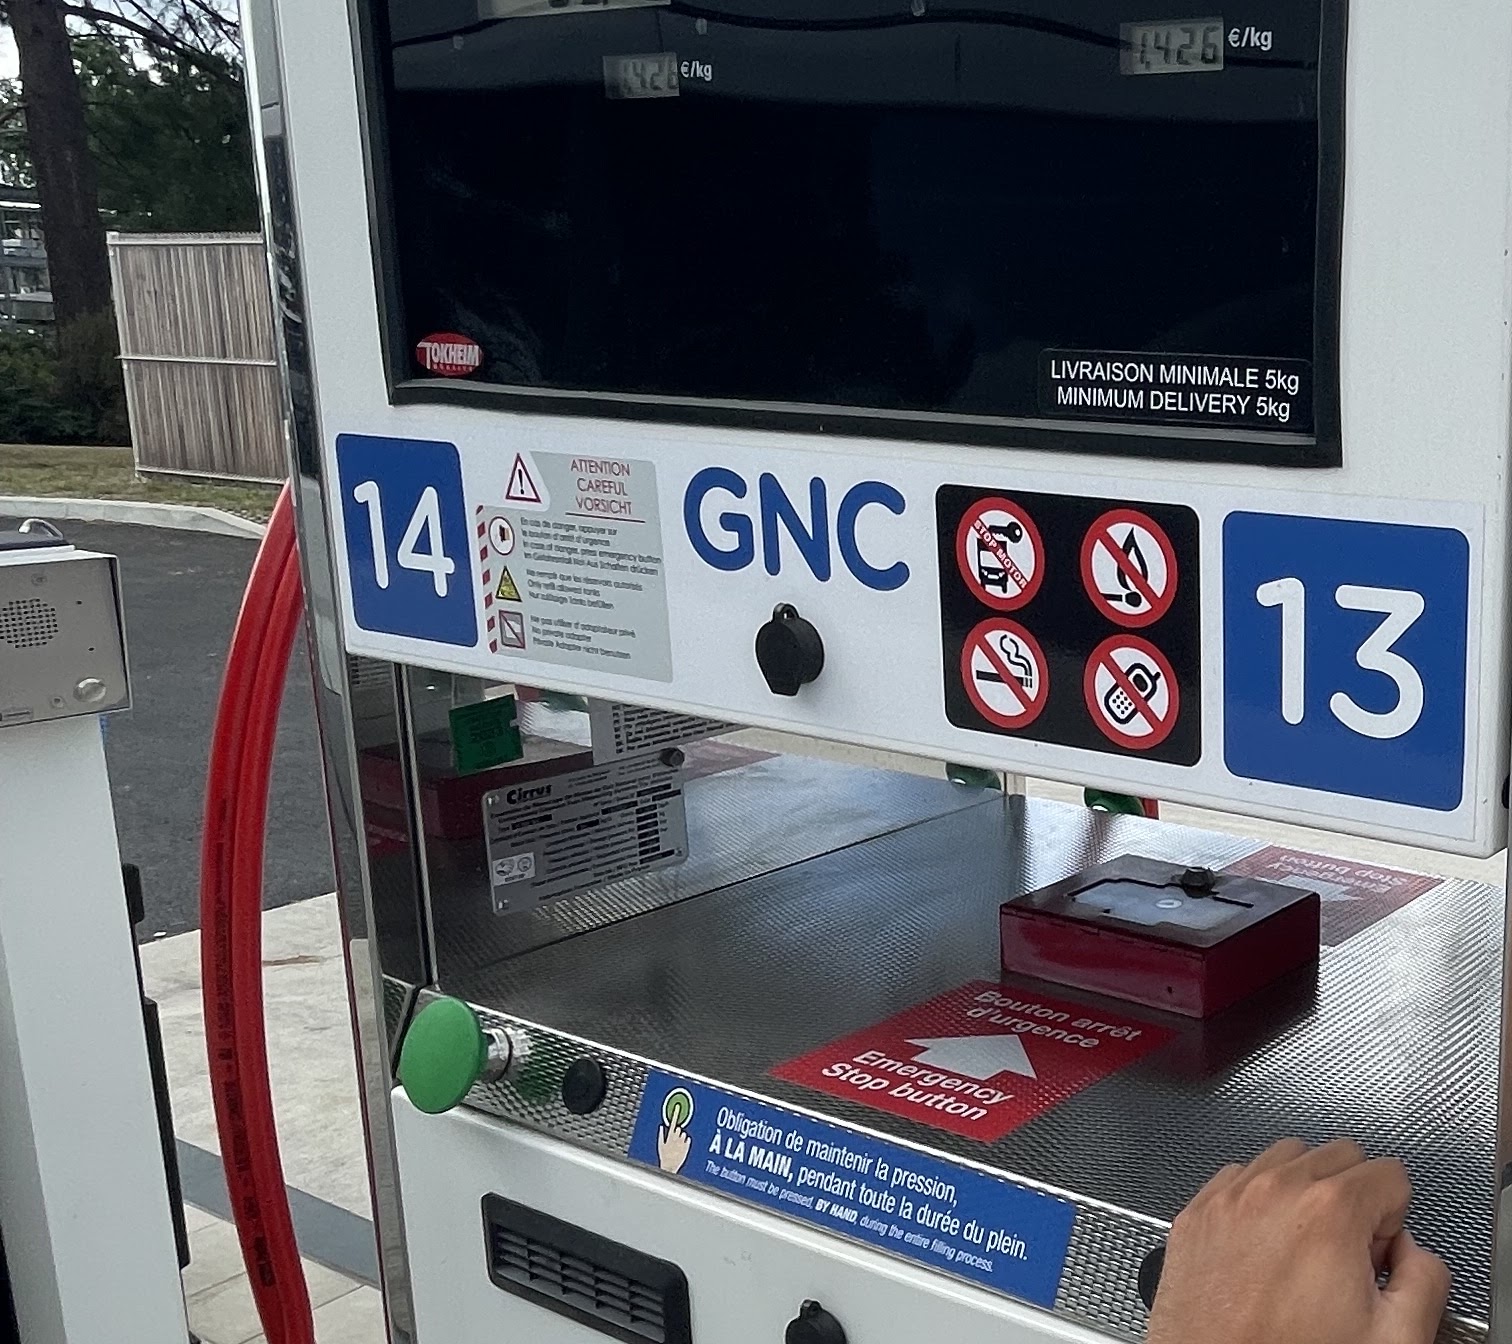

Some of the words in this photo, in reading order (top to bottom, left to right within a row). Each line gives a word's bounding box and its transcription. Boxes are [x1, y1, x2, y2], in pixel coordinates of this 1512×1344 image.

[1227, 27, 1273, 51] €/kg
[680, 60, 713, 82] €/kg
[416, 342, 480, 370] TOKHEIM
[1050, 359, 1154, 384] LIVRAISON
[1159, 364, 1260, 390] MINIMALE
[1265, 369, 1300, 396] 5kg
[1056, 385, 1144, 410] MINIMUM
[1149, 389, 1251, 416] DELIVERY
[1255, 395, 1291, 423] 5kg
[570, 458, 631, 477] ATTENTION
[576, 477, 628, 497] CAREFUL
[575, 496, 632, 516] VORSICHT
[683, 466, 910, 592] GNC
[354, 480, 456, 598] 14
[973, 519, 997, 549] STOP
[996, 548, 1028, 589] MOTOR
[1255, 577, 1425, 740] 13
[506, 784, 552, 806] Cirrus
[965, 1006, 1101, 1049] d'urgence
[973, 990, 1070, 1023] Bouton
[1071, 1017, 1143, 1042] arrêt
[821, 1061, 890, 1092] Stop
[889, 1081, 989, 1122] button
[851, 1049, 1015, 1106] Emergency
[716, 1106, 783, 1146] Obligation
[785, 1129, 804, 1152] de
[806, 1138, 874, 1175] maintenir
[875, 1156, 889, 1181] la
[890, 1167, 959, 1208] pression,
[704, 1159, 720, 1176] The
[719, 1166, 747, 1185] button
[746, 1175, 769, 1193] must
[768, 1182, 779, 1197] be
[815, 1197, 831, 1213] BY
[859, 1215, 889, 1237] during
[888, 1224, 904, 1240] the
[904, 1230, 931, 1249] entire
[930, 1237, 956, 1260] filling
[955, 1249, 994, 1273] process.
[708, 1128, 721, 1155] À
[724, 1137, 746, 1163] LA
[747, 1145, 794, 1183] MAIN,
[796, 1166, 857, 1200] pendant
[859, 1182, 896, 1214] toute
[899, 1196, 912, 1220] la
[916, 1203, 960, 1236] durée
[963, 1219, 985, 1245] du
[985, 1228, 1029, 1261] plein.
